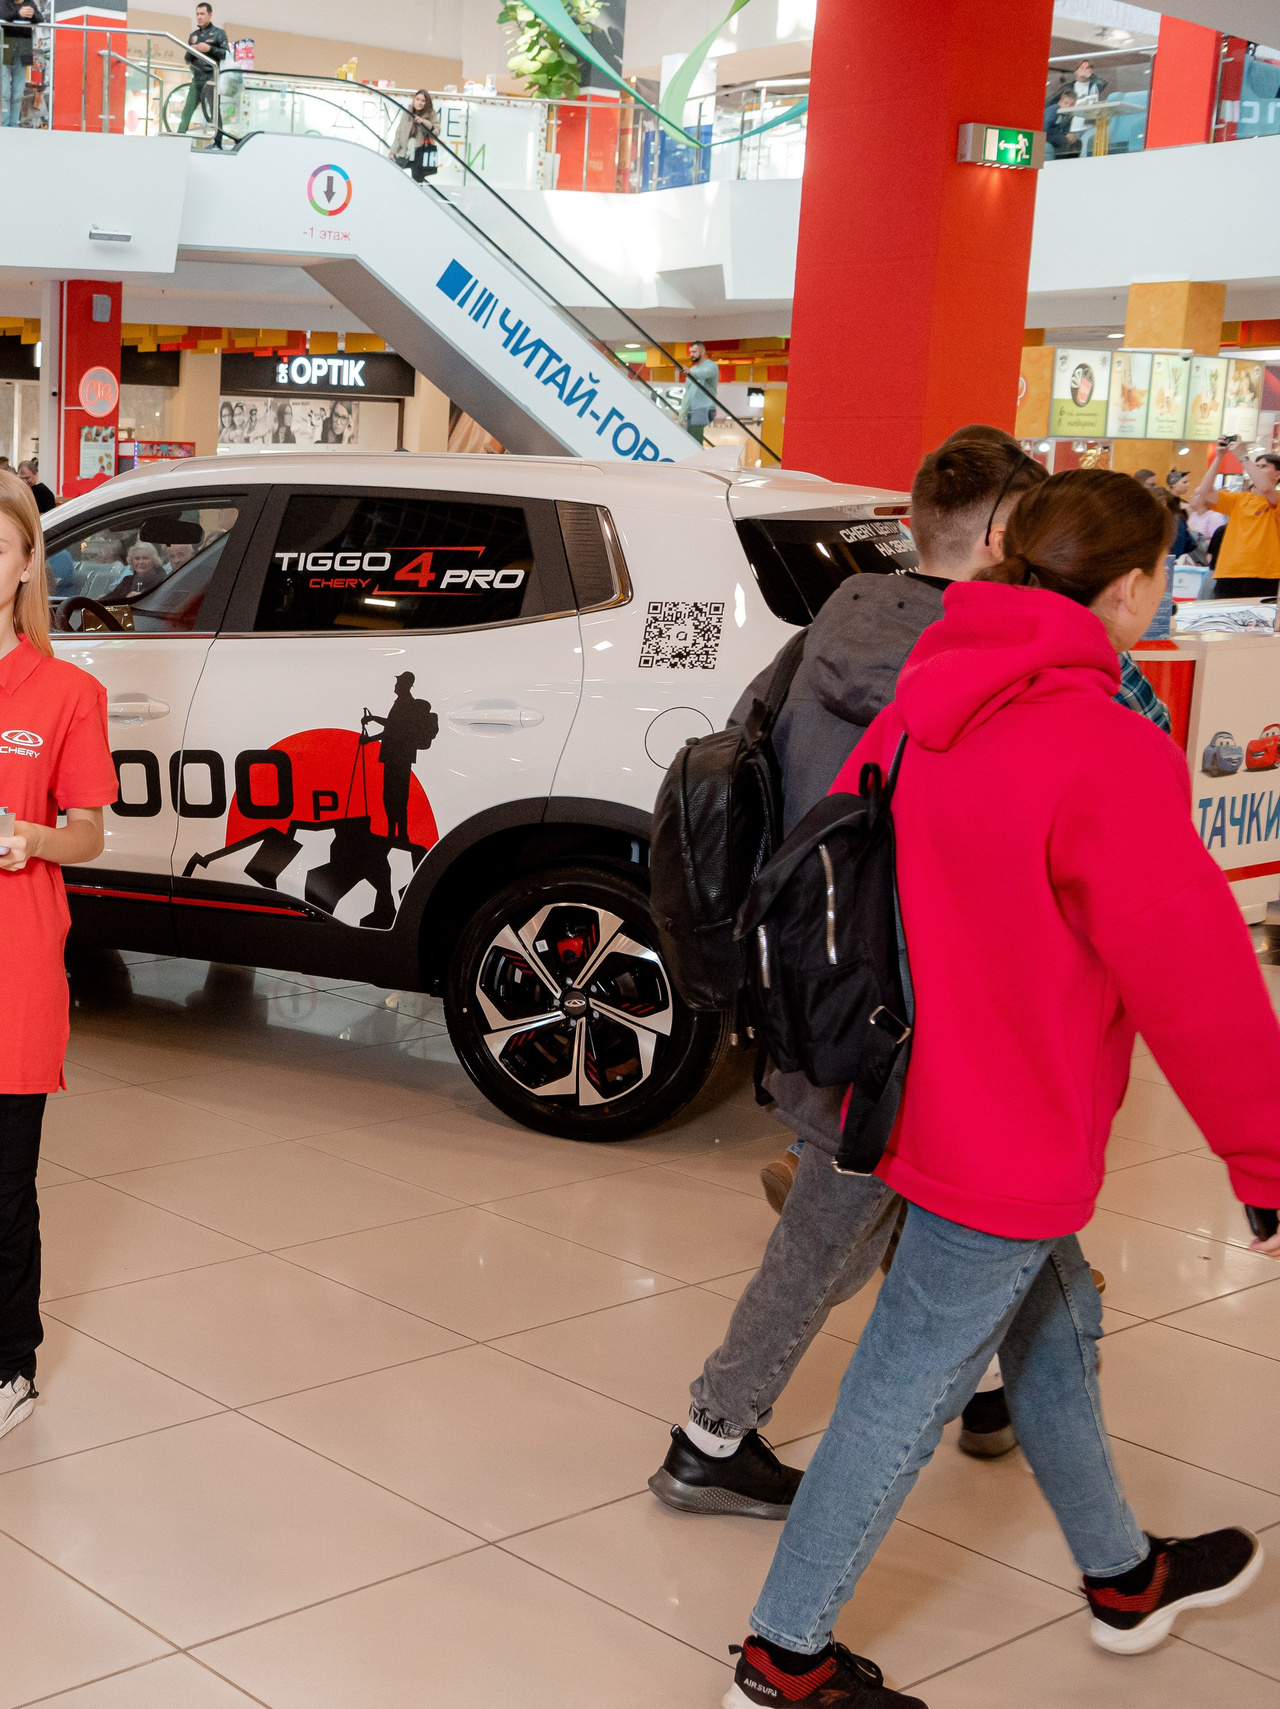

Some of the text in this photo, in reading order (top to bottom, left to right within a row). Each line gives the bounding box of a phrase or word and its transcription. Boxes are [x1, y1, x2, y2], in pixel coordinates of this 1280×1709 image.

[303, 227, 351, 241] -1 этаж
[290, 356, 366, 387] OPTIK
[498, 307, 676, 463] ЧИТАЙ-ГОР
[839, 523, 876, 543] CHERY
[875, 542, 896, 557] НА
[275, 551, 526, 589] TIGGO 4 PRO
[309, 578, 373, 588] CHERY
[0, 745, 40, 758] CHERY
[1198, 790, 1280, 851] ТАЧКИ
